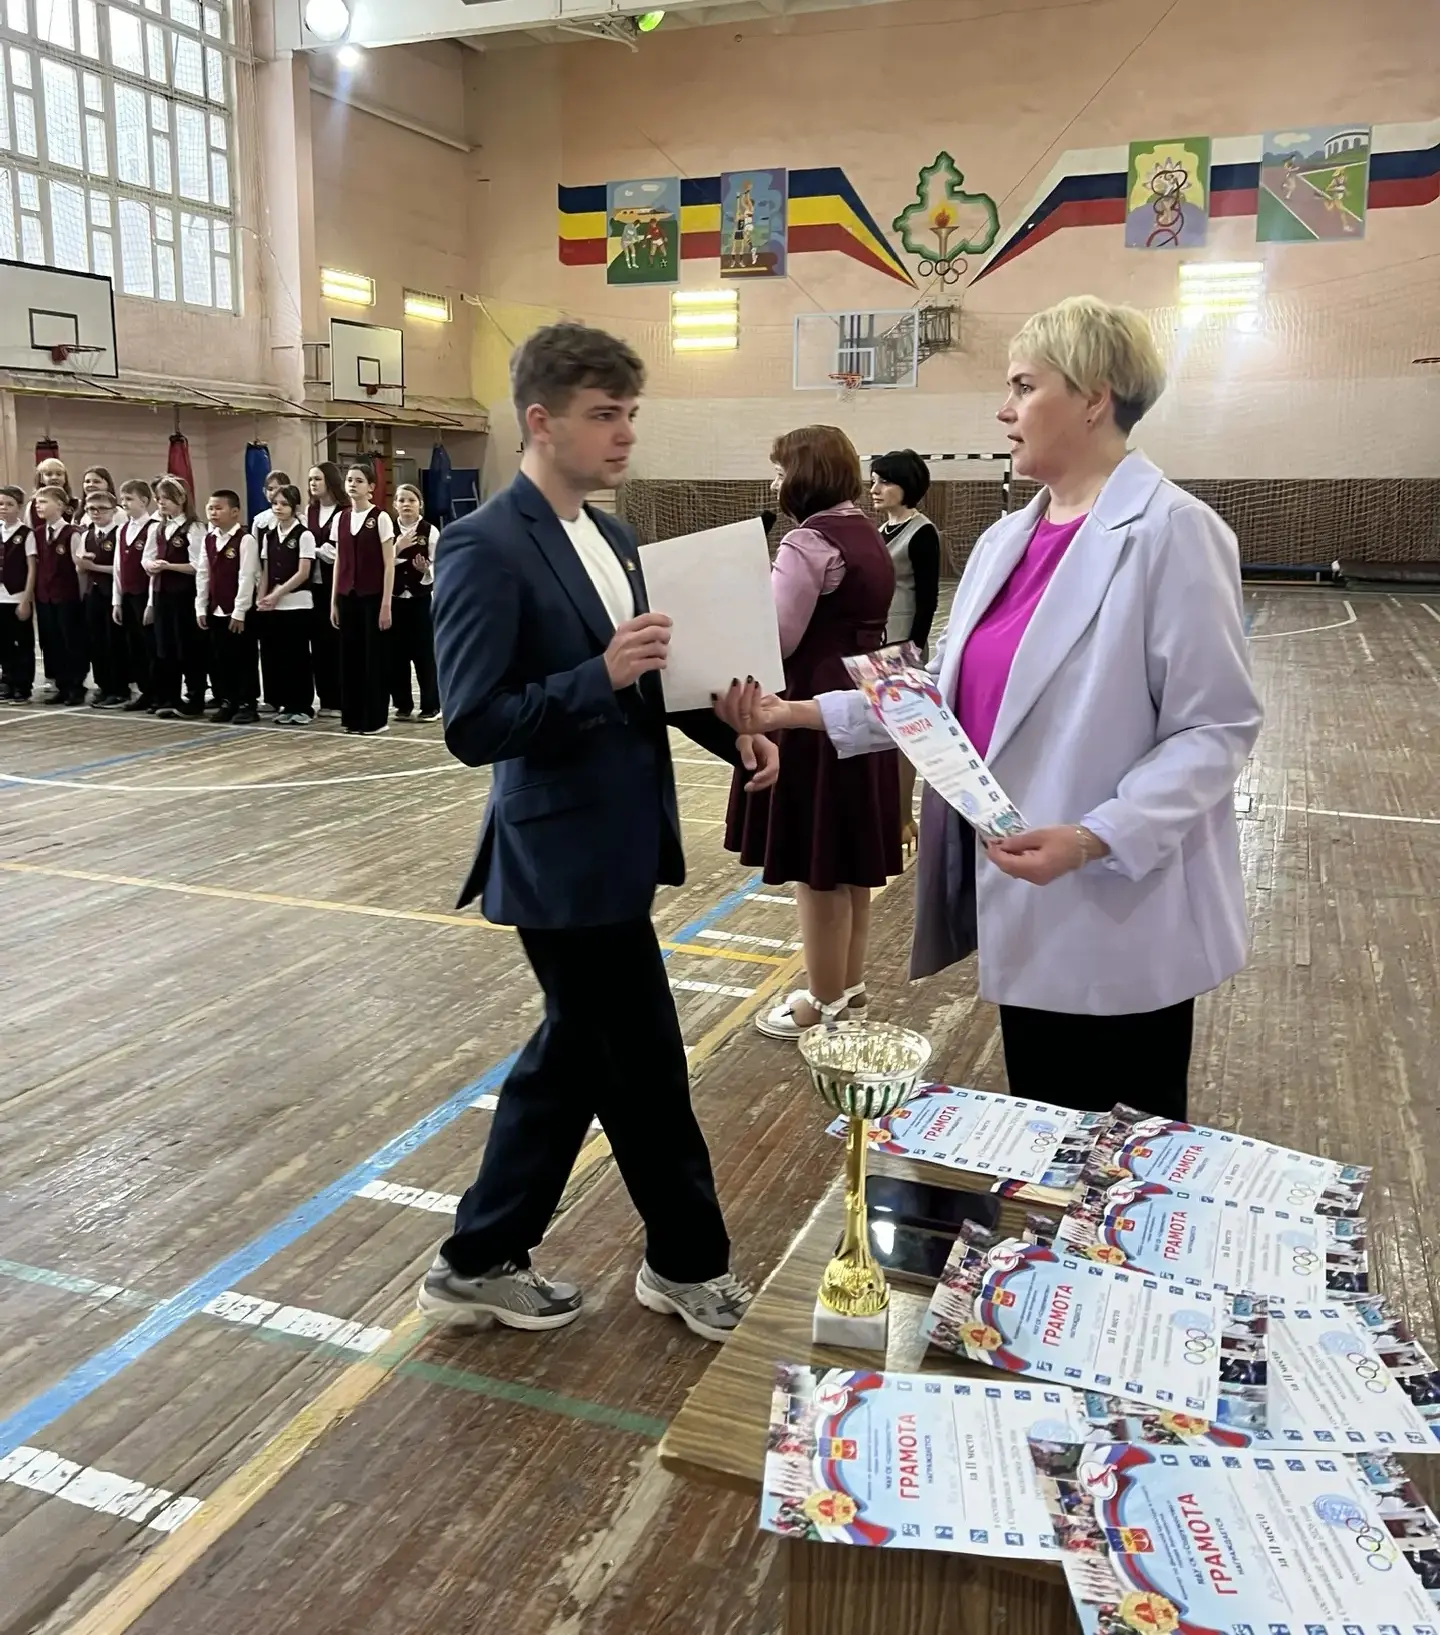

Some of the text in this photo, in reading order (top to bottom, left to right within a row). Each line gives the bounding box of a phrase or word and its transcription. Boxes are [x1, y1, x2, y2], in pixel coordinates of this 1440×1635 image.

[922, 1104, 959, 1142] ГРАМОТА
[1167, 1143, 1205, 1184] ГРАМОТА
[1163, 1209, 1187, 1262] ГРАМОТА
[1042, 1283, 1073, 1347] ГРАМОТА
[898, 1413, 920, 1499] ГРАМОТА
[1174, 1493, 1239, 1594] ГРАМОТА
[1254, 1513, 1277, 1543] место
